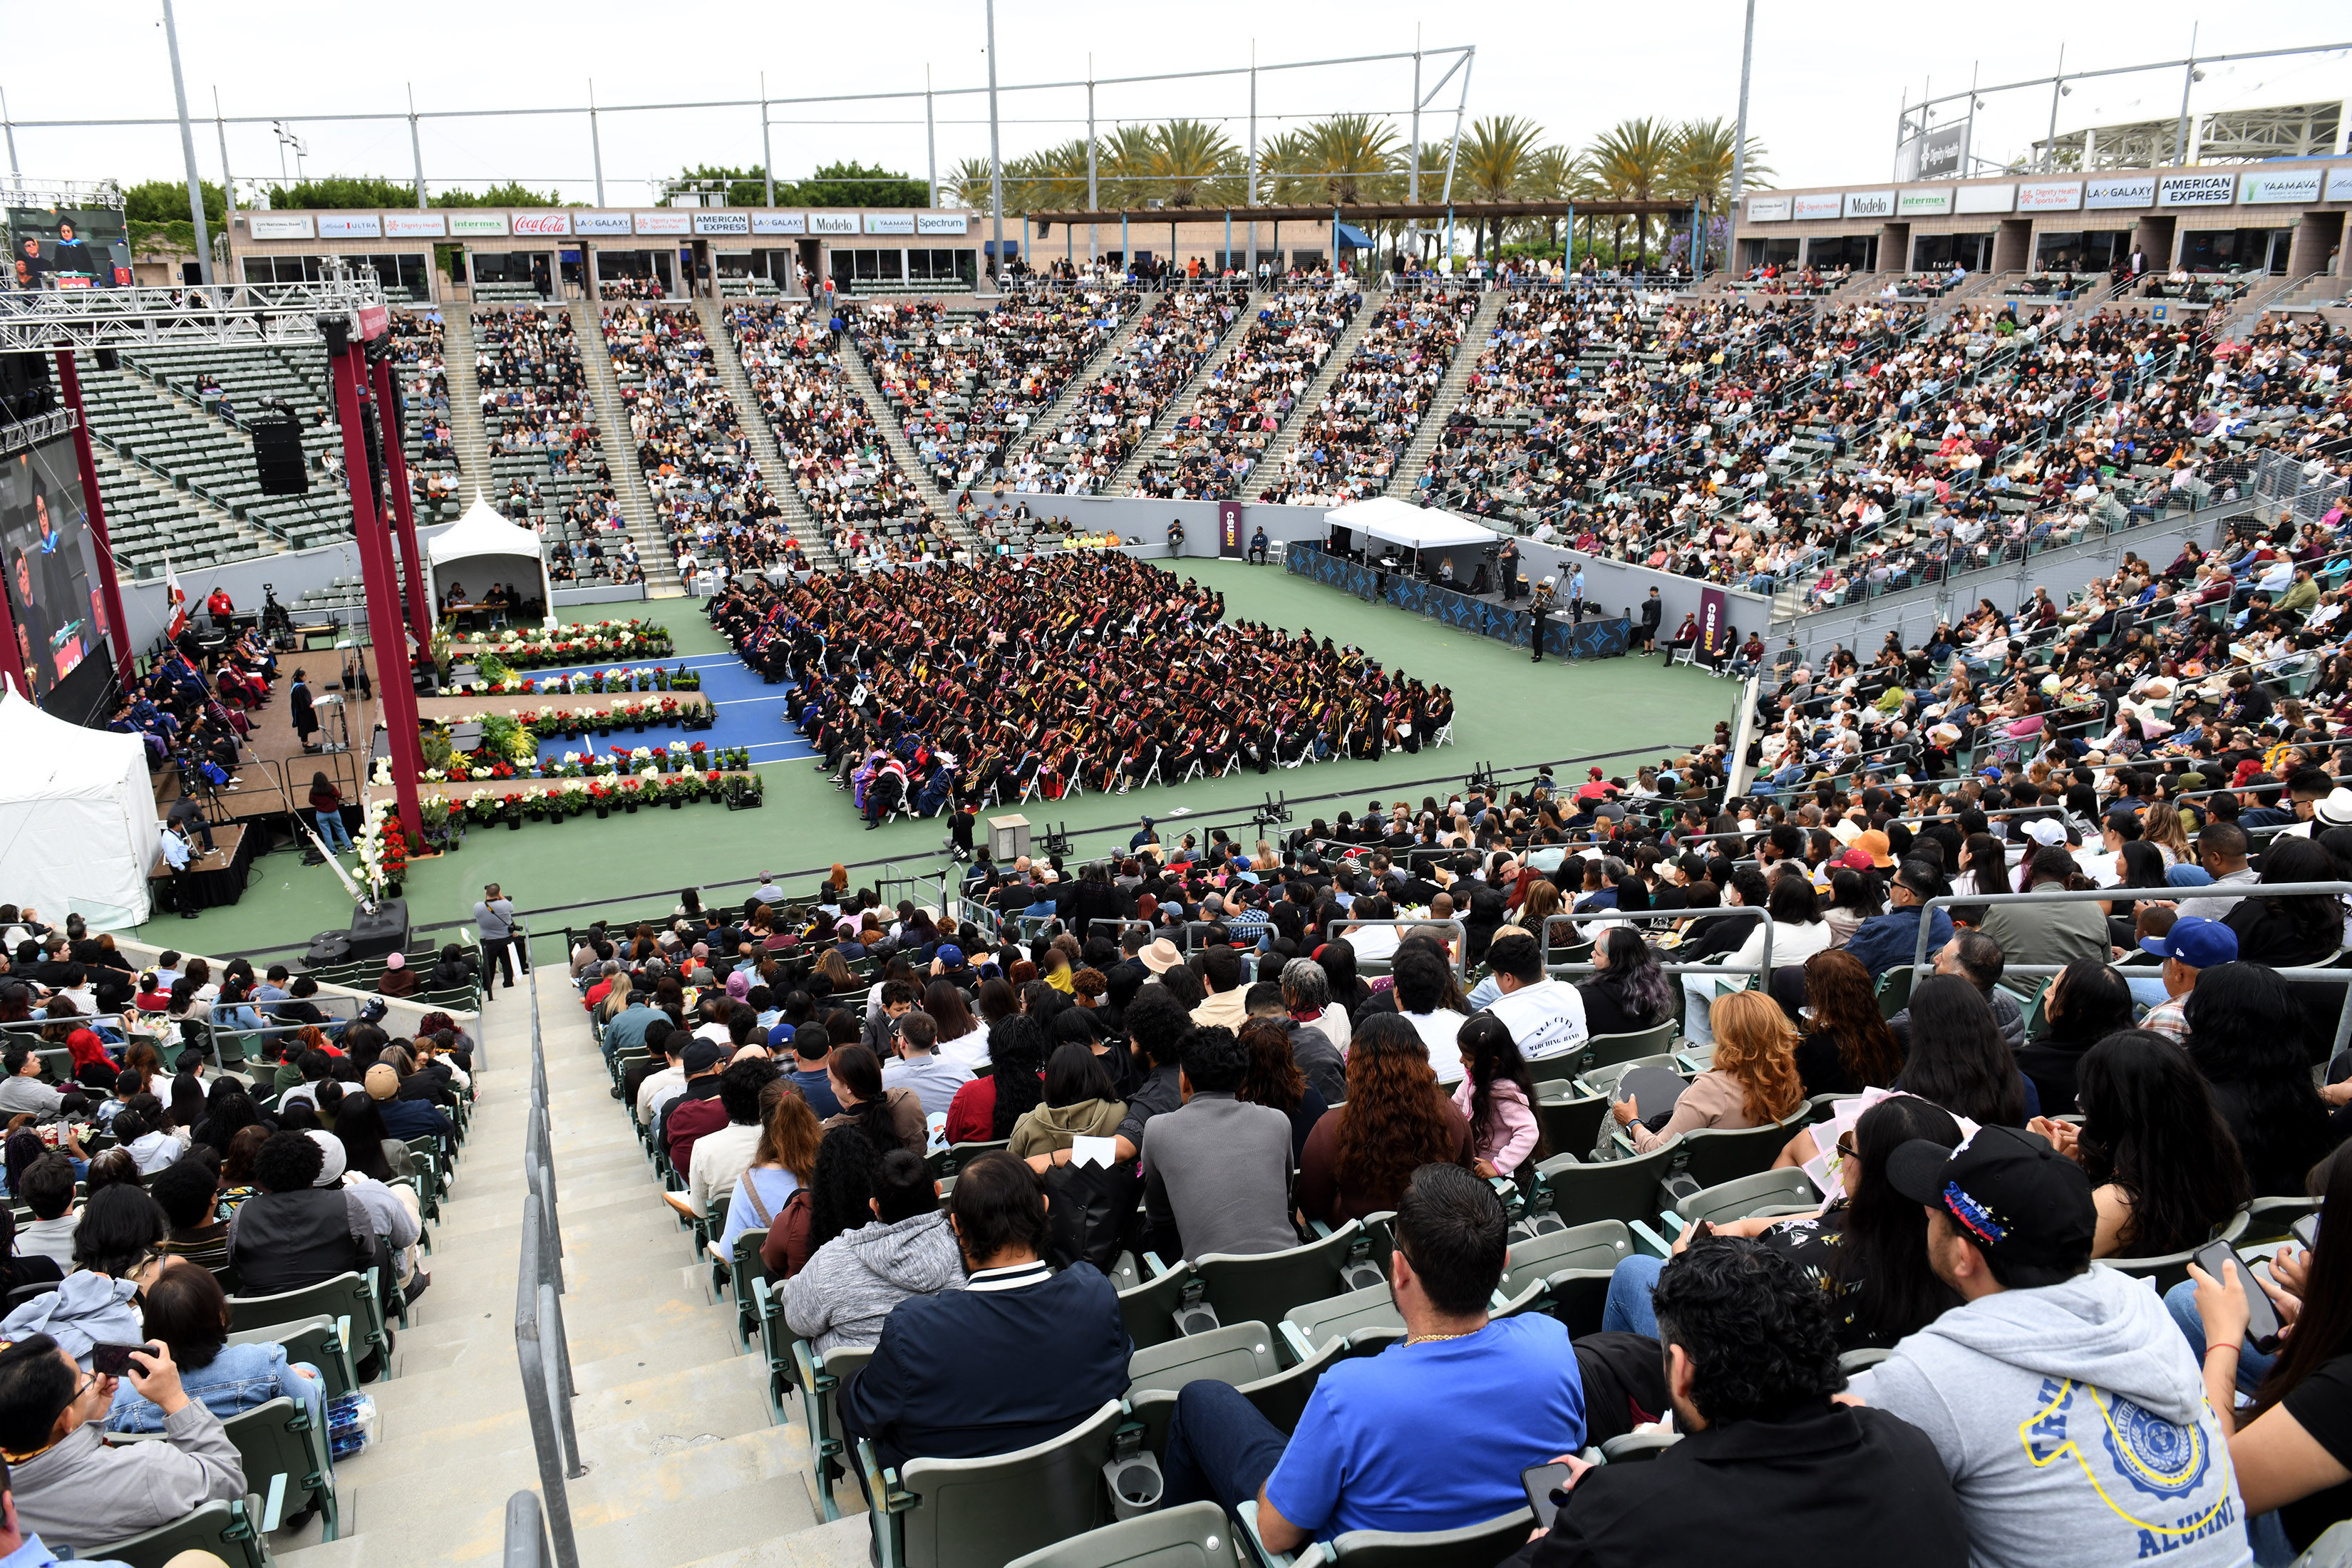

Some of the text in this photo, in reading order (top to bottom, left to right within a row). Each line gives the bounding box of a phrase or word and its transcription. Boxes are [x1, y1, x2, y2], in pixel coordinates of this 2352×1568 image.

[1929, 147, 1944, 165] Dignity
[2162, 178, 2231, 190] AMERICAN
[2036, 187, 2078, 200] Dignity Health
[2087, 186, 2152, 198] LA GALAXY
[2170, 190, 2230, 202] EXPRESS
[1852, 197, 1887, 214] Modelo
[1903, 196, 1946, 206] intermex
[2036, 197, 2054, 205] Sports
[1807, 203, 1822, 212] Dignity
[401, 222, 422, 230] Dignity
[649, 217, 668, 226] Dignity
[772, 219, 804, 227] GALAXY
[816, 218, 852, 231] Modelo
[919, 218, 962, 229] Spectrum
[2156, 309, 2164, 317] 2
[1704, 602, 1716, 651] CSUDH
[1536, 1017, 1574, 1036] ALL CITY
[1528, 1038, 1562, 1052] MARCHING
[2138, 1497, 2235, 1559] ALUMNI
